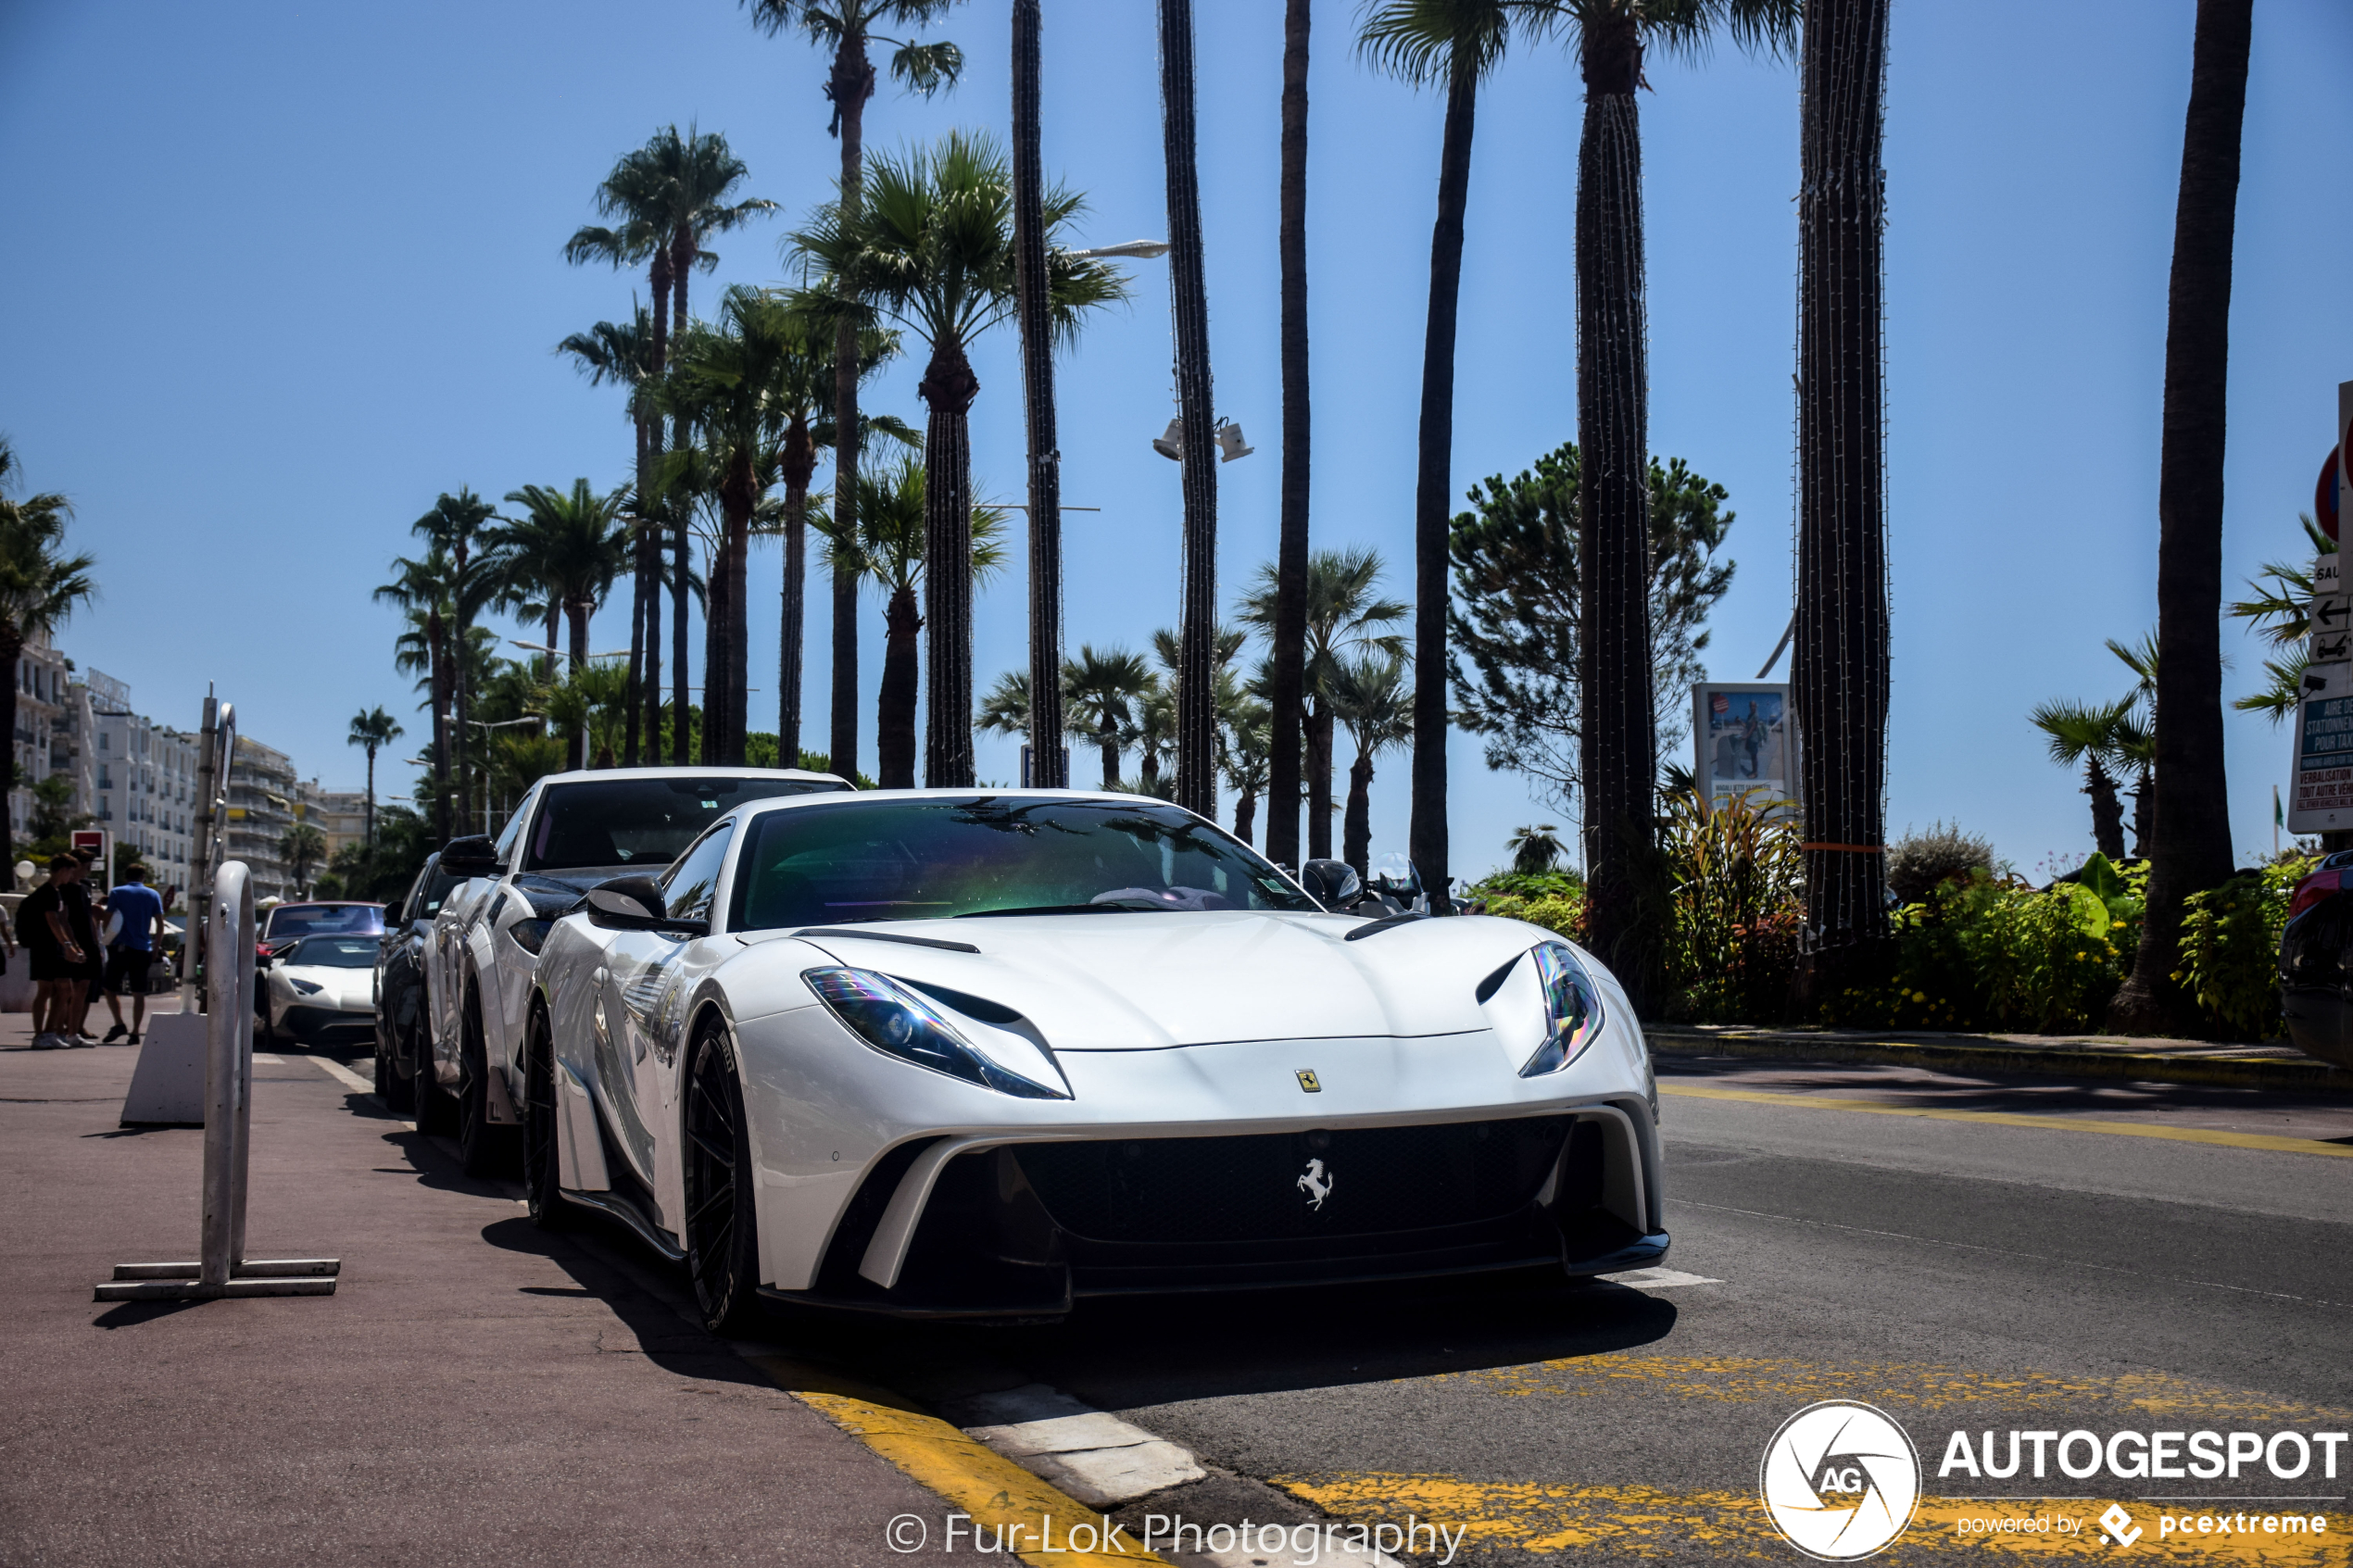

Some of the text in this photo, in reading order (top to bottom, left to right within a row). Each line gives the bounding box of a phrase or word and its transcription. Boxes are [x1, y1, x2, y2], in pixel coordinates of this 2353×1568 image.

[2324, 700, 2343, 716] AIRE
[2314, 735, 2336, 751] POUR
[2299, 768, 2351, 784] VERBALISATION
[2299, 785, 2315, 798] TOUT
[2316, 784, 2336, 797] AUTRE
